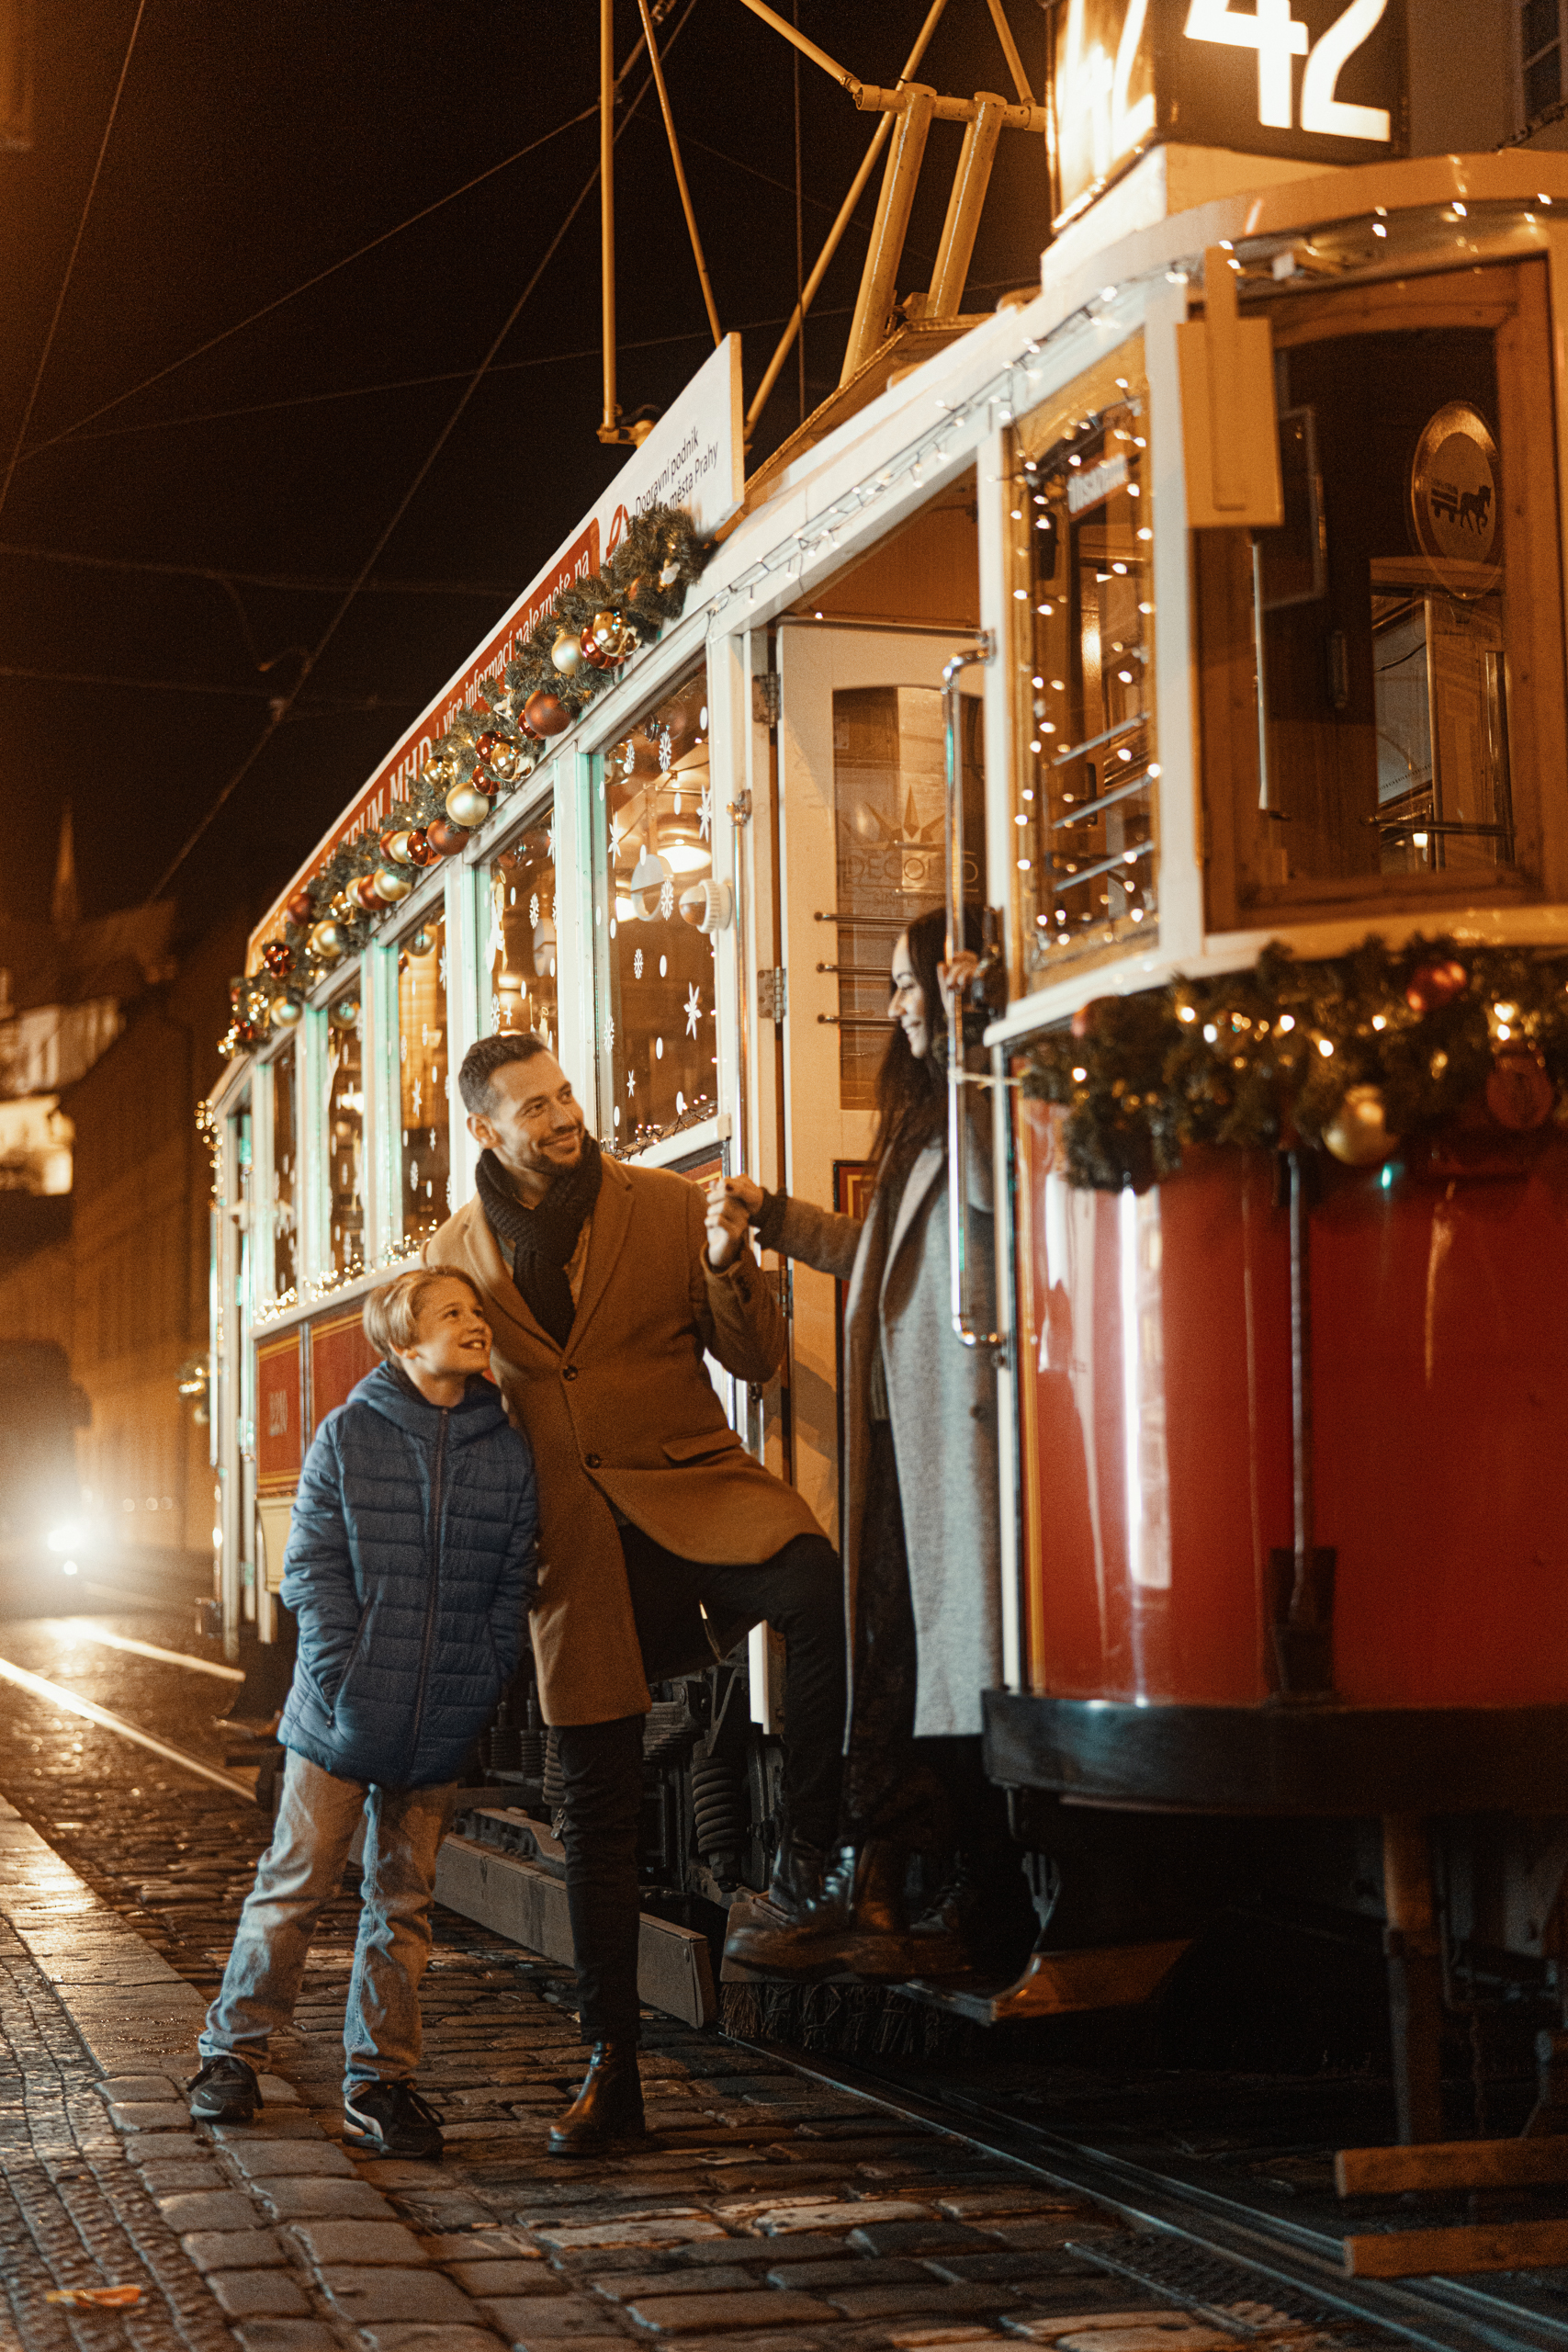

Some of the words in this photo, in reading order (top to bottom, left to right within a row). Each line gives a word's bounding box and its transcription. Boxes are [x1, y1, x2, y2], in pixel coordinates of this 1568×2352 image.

[1183, 0, 1391, 141] 42
[636, 458, 671, 517] Dopravní
[671, 426, 699, 484] podnik
[670, 479, 694, 511] města
[695, 442, 718, 485] Prahy
[389, 735, 433, 814] MHD
[574, 550, 590, 584] na
